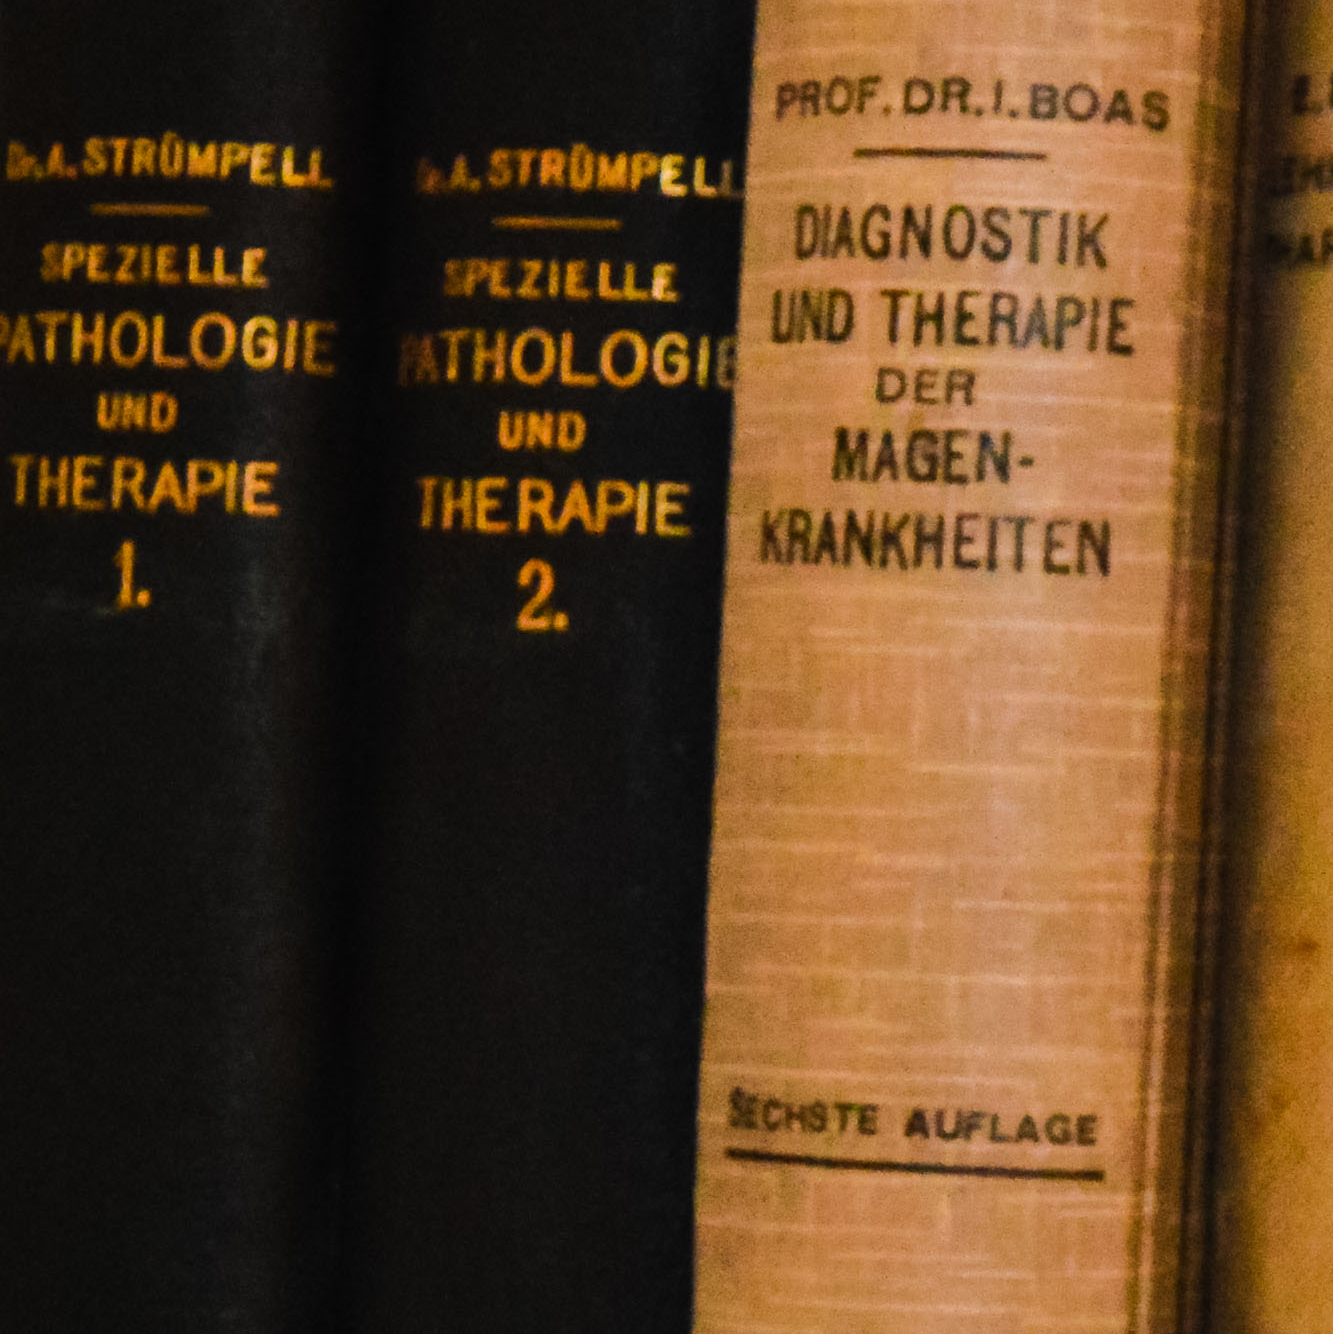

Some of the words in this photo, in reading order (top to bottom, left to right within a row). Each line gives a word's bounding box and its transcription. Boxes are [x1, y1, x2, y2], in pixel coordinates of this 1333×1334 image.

[40, 242, 271, 290] SPEZIELLE
[794, 202, 1110, 270] DIAGNOSTIK
[443, 257, 681, 304] SPEZIELLE
[770, 287, 855, 345] UND
[880, 288, 1138, 356] THERAPIE
[96, 391, 180, 433] UND
[875, 367, 977, 406] DER
[498, 410, 589, 454] UND
[830, 425, 1035, 485] MAGEN-
[9, 454, 282, 518] THERAPIE
[416, 477, 694, 537] THERAPIE
[758, 507, 1113, 578] KRANKHEITEN
[515, 558, 571, 633] 2.
[904, 1107, 1099, 1146] AUFLAGE
